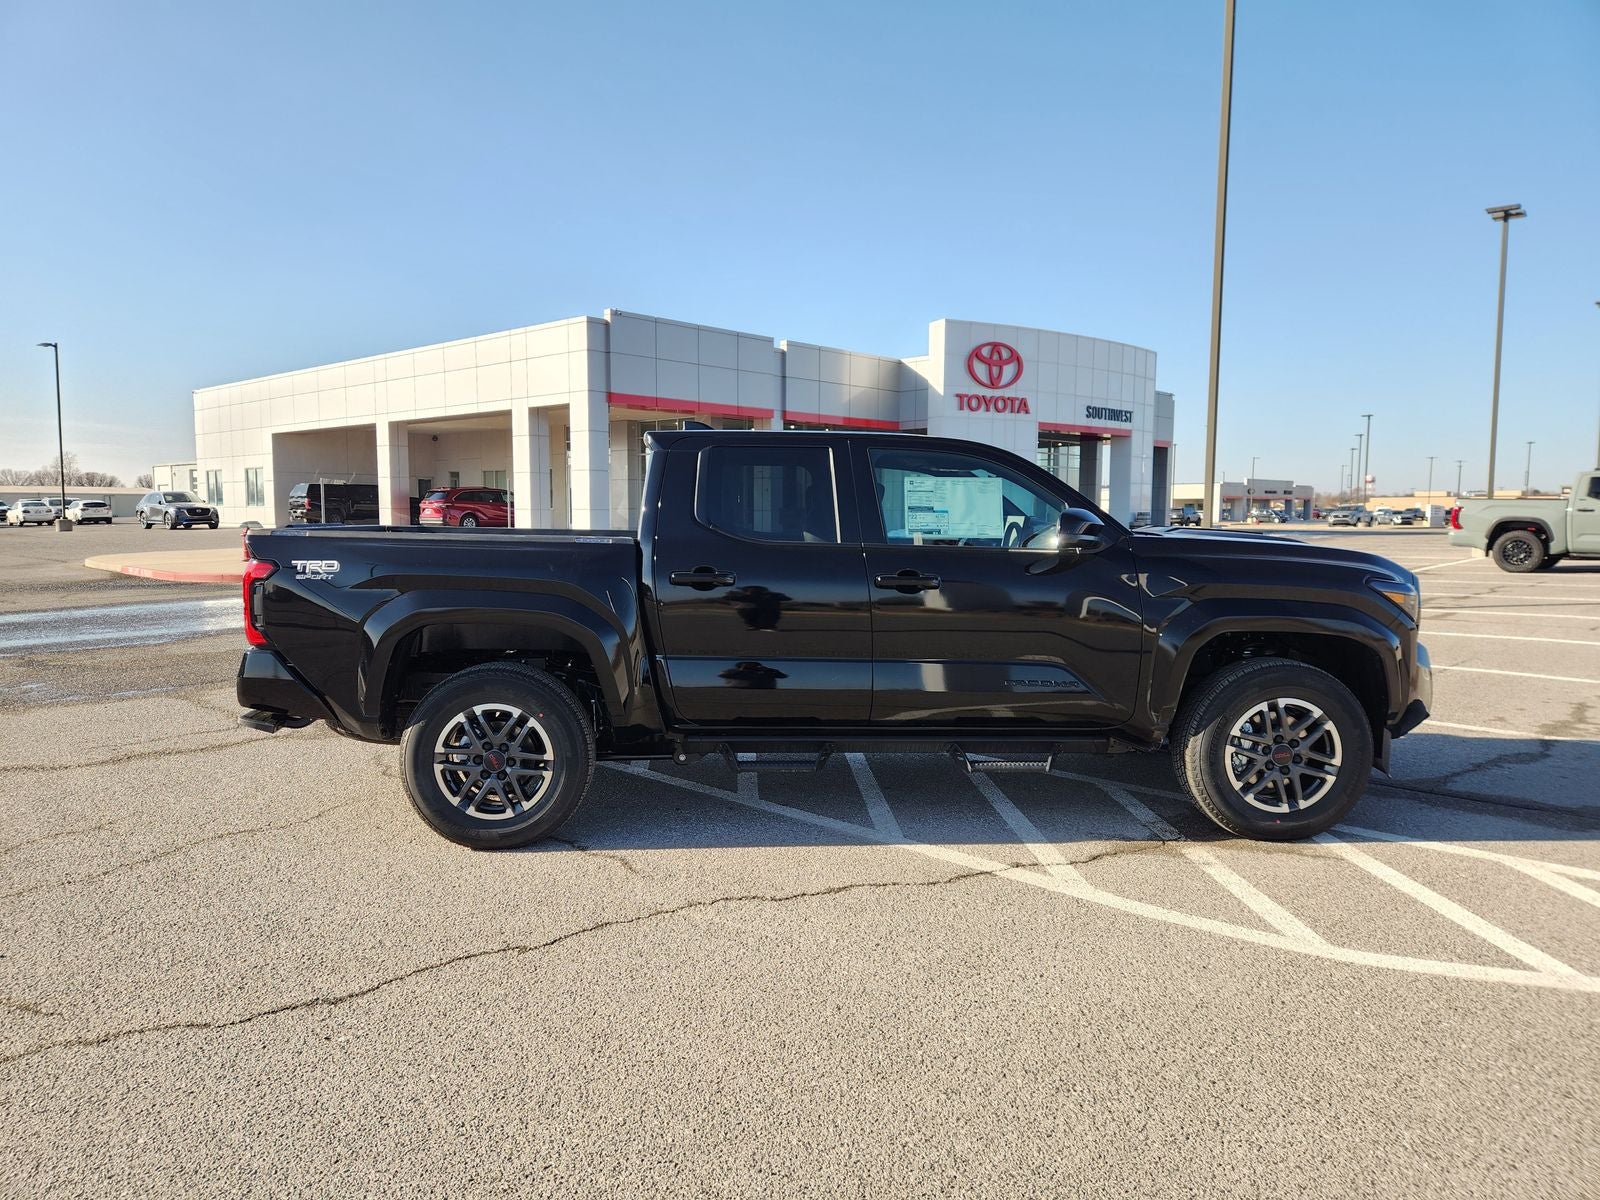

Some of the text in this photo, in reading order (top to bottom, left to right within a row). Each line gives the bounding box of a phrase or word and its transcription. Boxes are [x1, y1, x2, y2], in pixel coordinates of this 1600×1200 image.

[955, 393, 1031, 415] TOYOTA
[1085, 405, 1133, 423] SOUTHWEST
[291, 560, 340, 573] TRD
